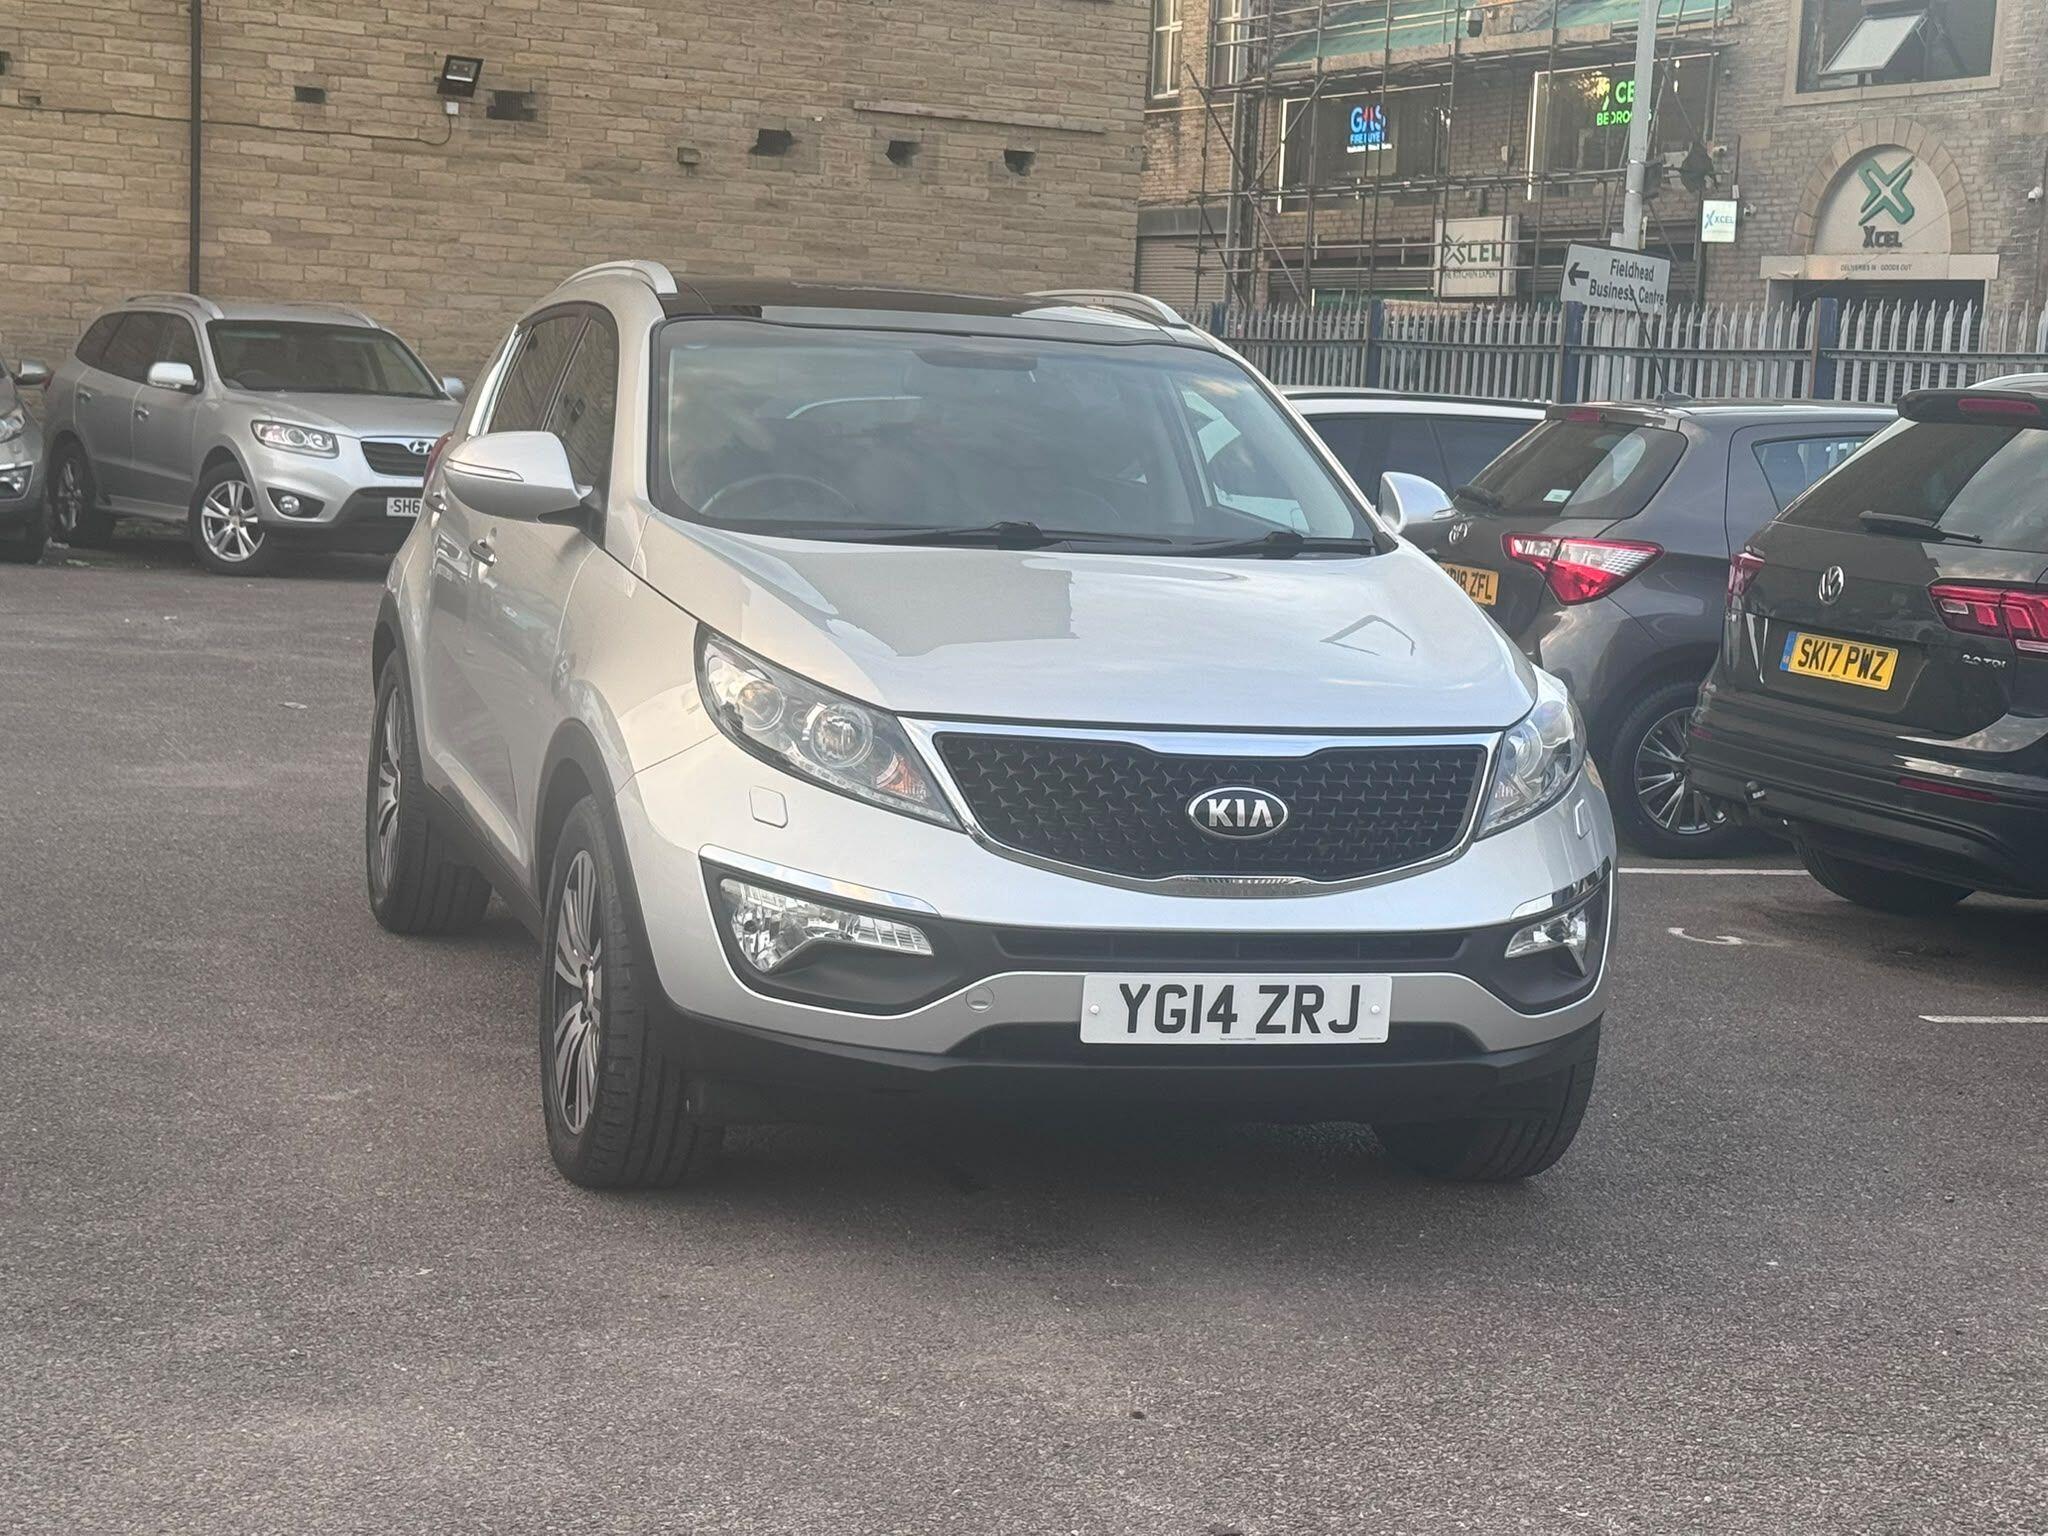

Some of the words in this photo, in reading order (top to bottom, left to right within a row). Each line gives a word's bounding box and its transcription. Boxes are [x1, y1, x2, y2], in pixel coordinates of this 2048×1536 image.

[1863, 225, 1903, 249] XCEL
[1609, 258, 1655, 282] Fieldhead
[1589, 278, 1634, 301] Business
[1638, 286, 1665, 306] Centre
[1469, 571, 1492, 600] ZFL
[1797, 638, 1843, 673] SK17
[1842, 645, 1889, 682] PWZ
[1207, 798, 1274, 827] KIA
[1119, 983, 1238, 1034] YG14
[1255, 984, 1361, 1034] ZRJ
